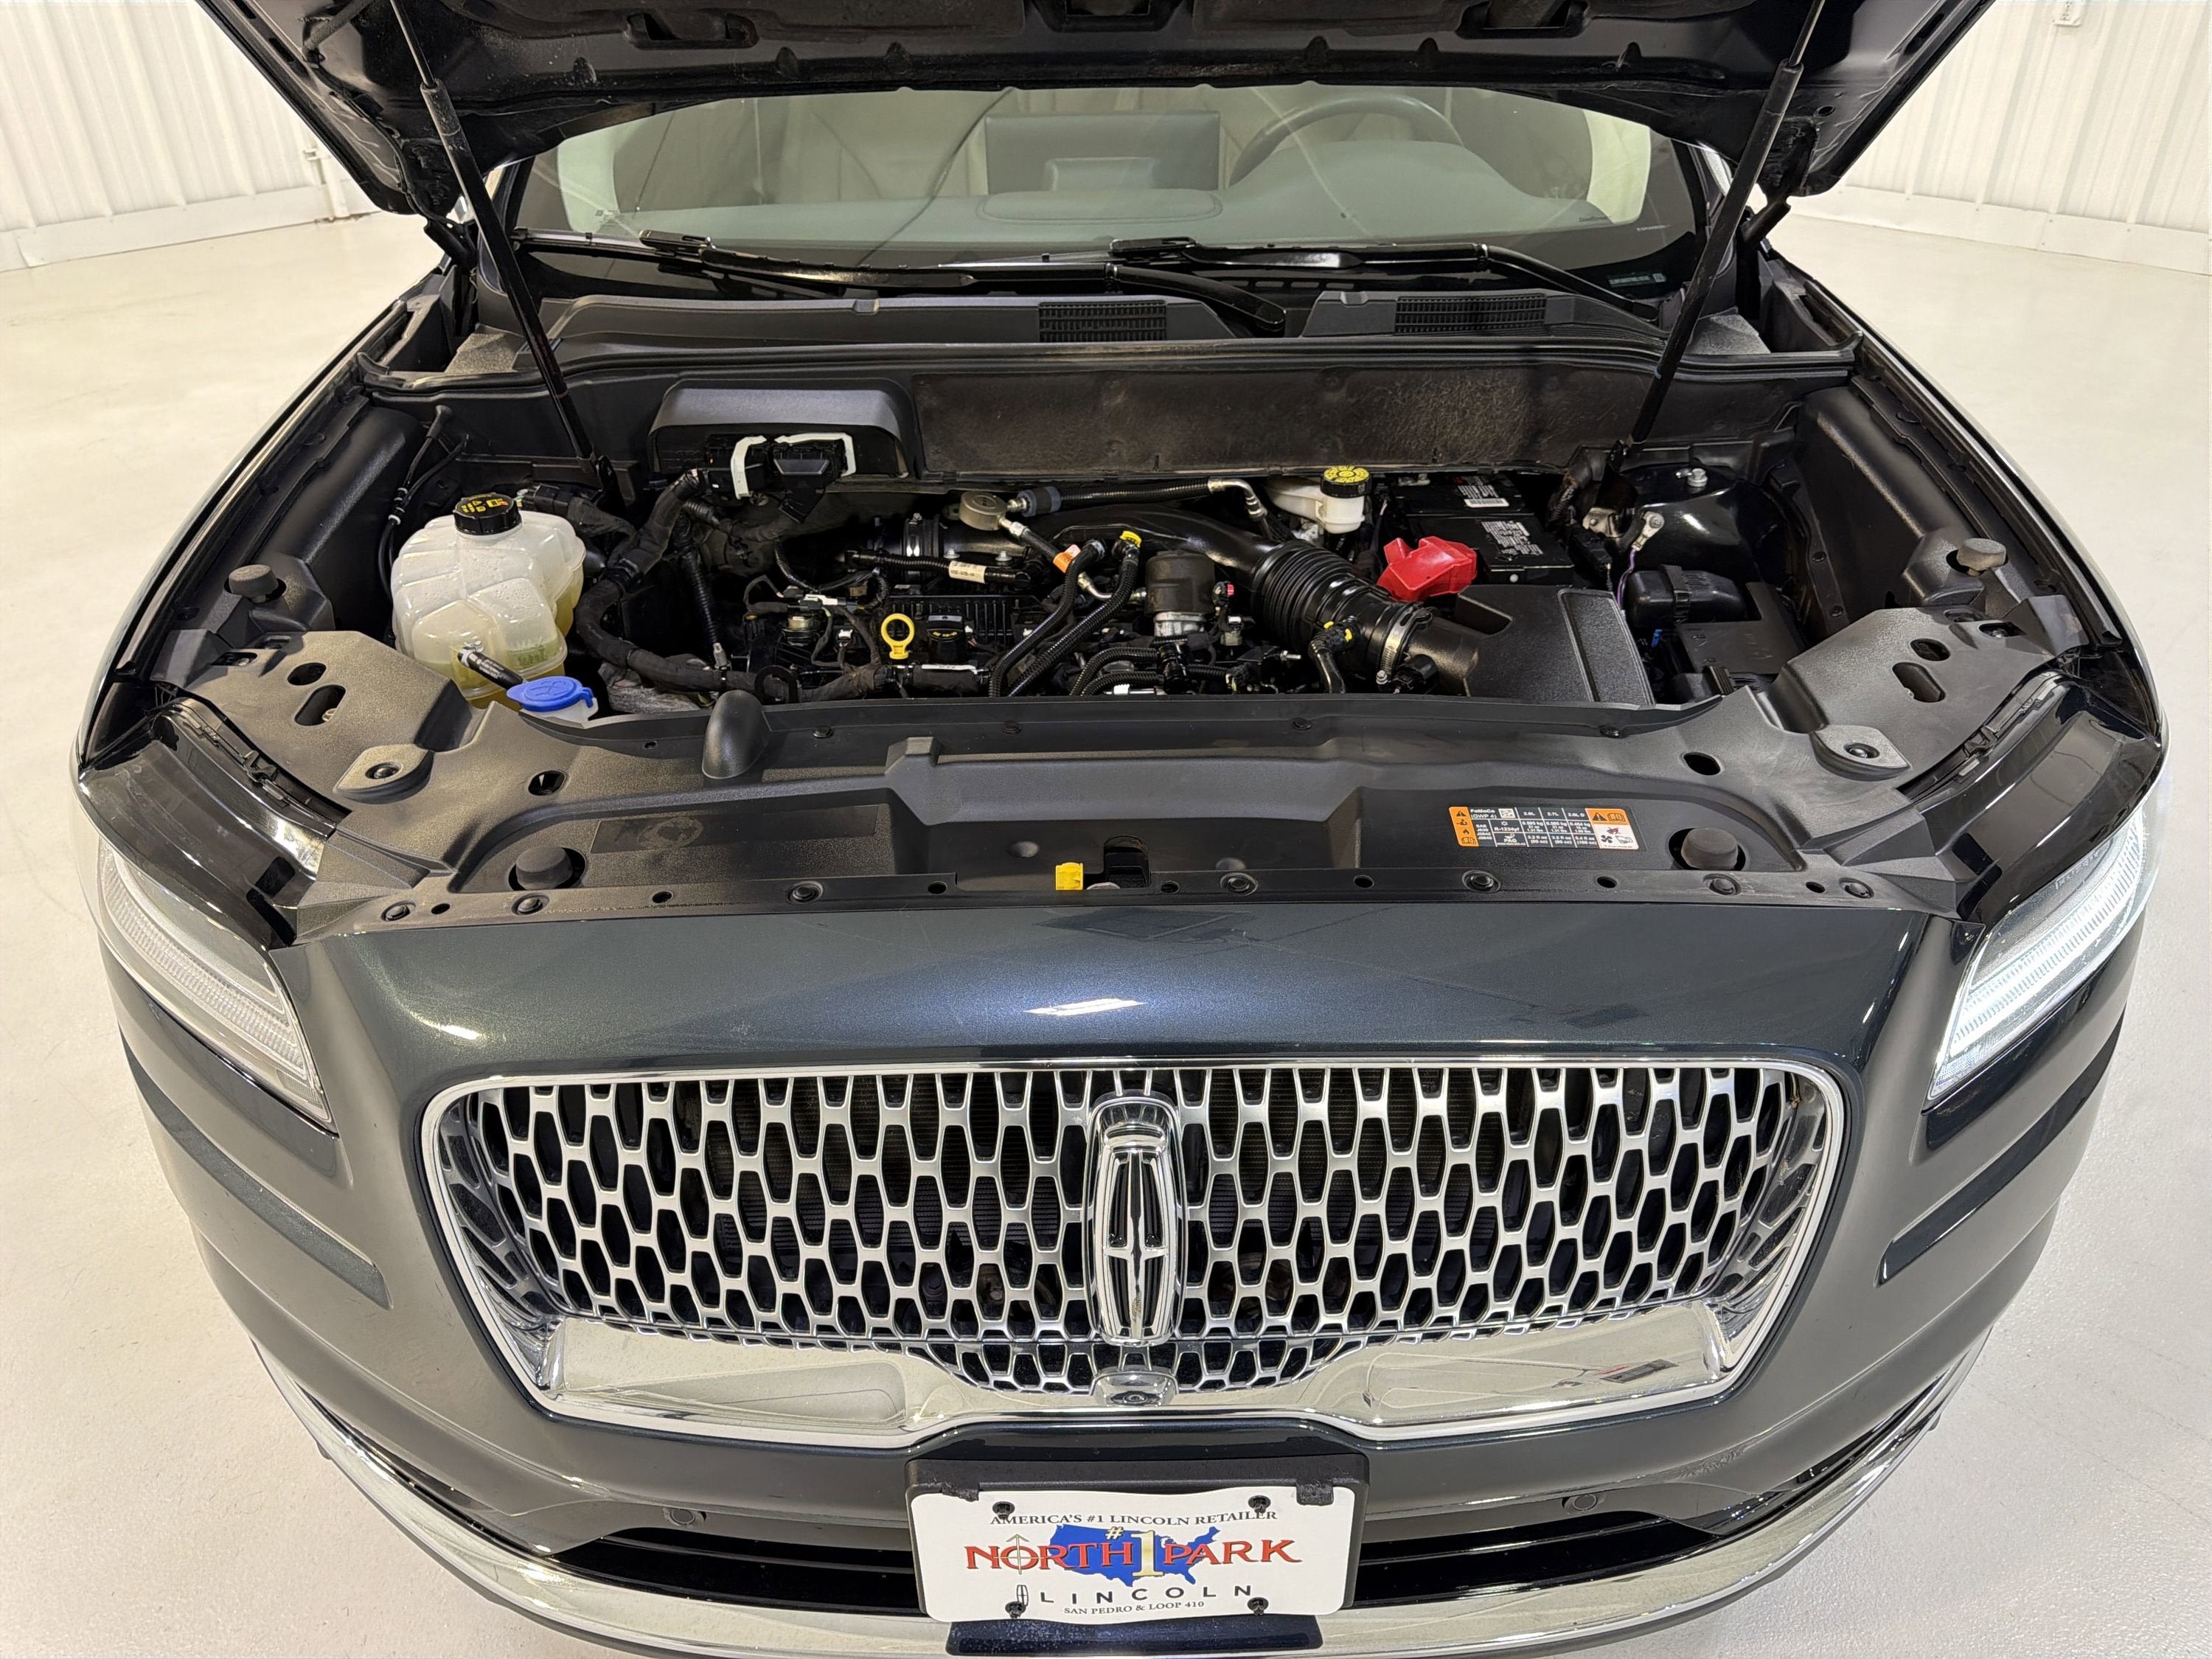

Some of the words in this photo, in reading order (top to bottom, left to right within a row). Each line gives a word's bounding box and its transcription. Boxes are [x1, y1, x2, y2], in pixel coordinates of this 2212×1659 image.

[990, 1514, 1082, 1525] AMERICA'S
[1087, 1515, 1103, 1523] #1
[1110, 1515, 1190, 1526] LINCOLN
[1194, 1512, 1278, 1525] RETAILER
[964, 1542, 1134, 1571] NORTH
[1163, 1540, 1303, 1565] PARK
[1040, 1585, 1251, 1604] LINCOLN
[1091, 1605, 1133, 1614] PEDRO
[1148, 1602, 1181, 1610] LOOP
